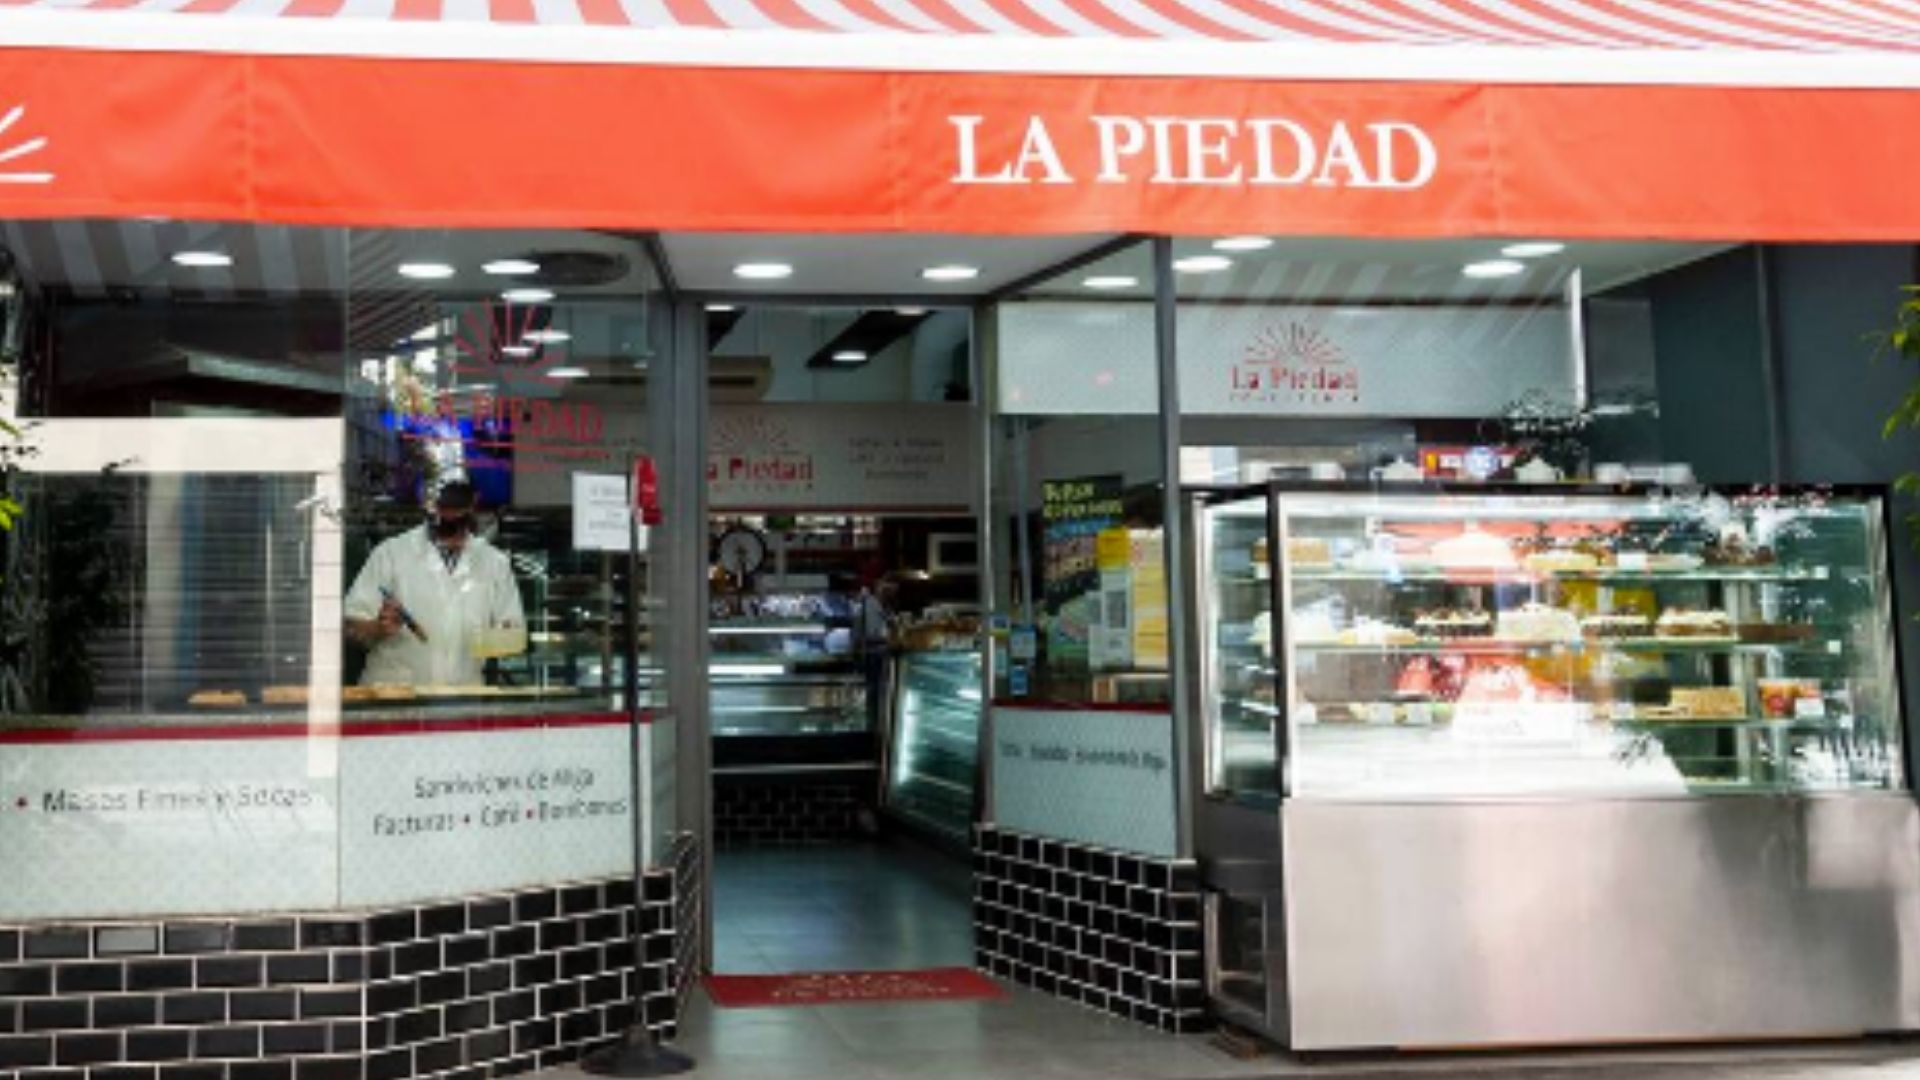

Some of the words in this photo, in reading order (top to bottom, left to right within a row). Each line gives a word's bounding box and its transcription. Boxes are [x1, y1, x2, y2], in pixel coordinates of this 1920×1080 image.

[947, 115, 1073, 184] LA
[1090, 115, 1437, 190] PIEDAD
[1231, 367, 1259, 389] La
[1270, 366, 1358, 390] Piedad
[471, 394, 603, 442] PIEDAD
[729, 455, 813, 481] Piedad
